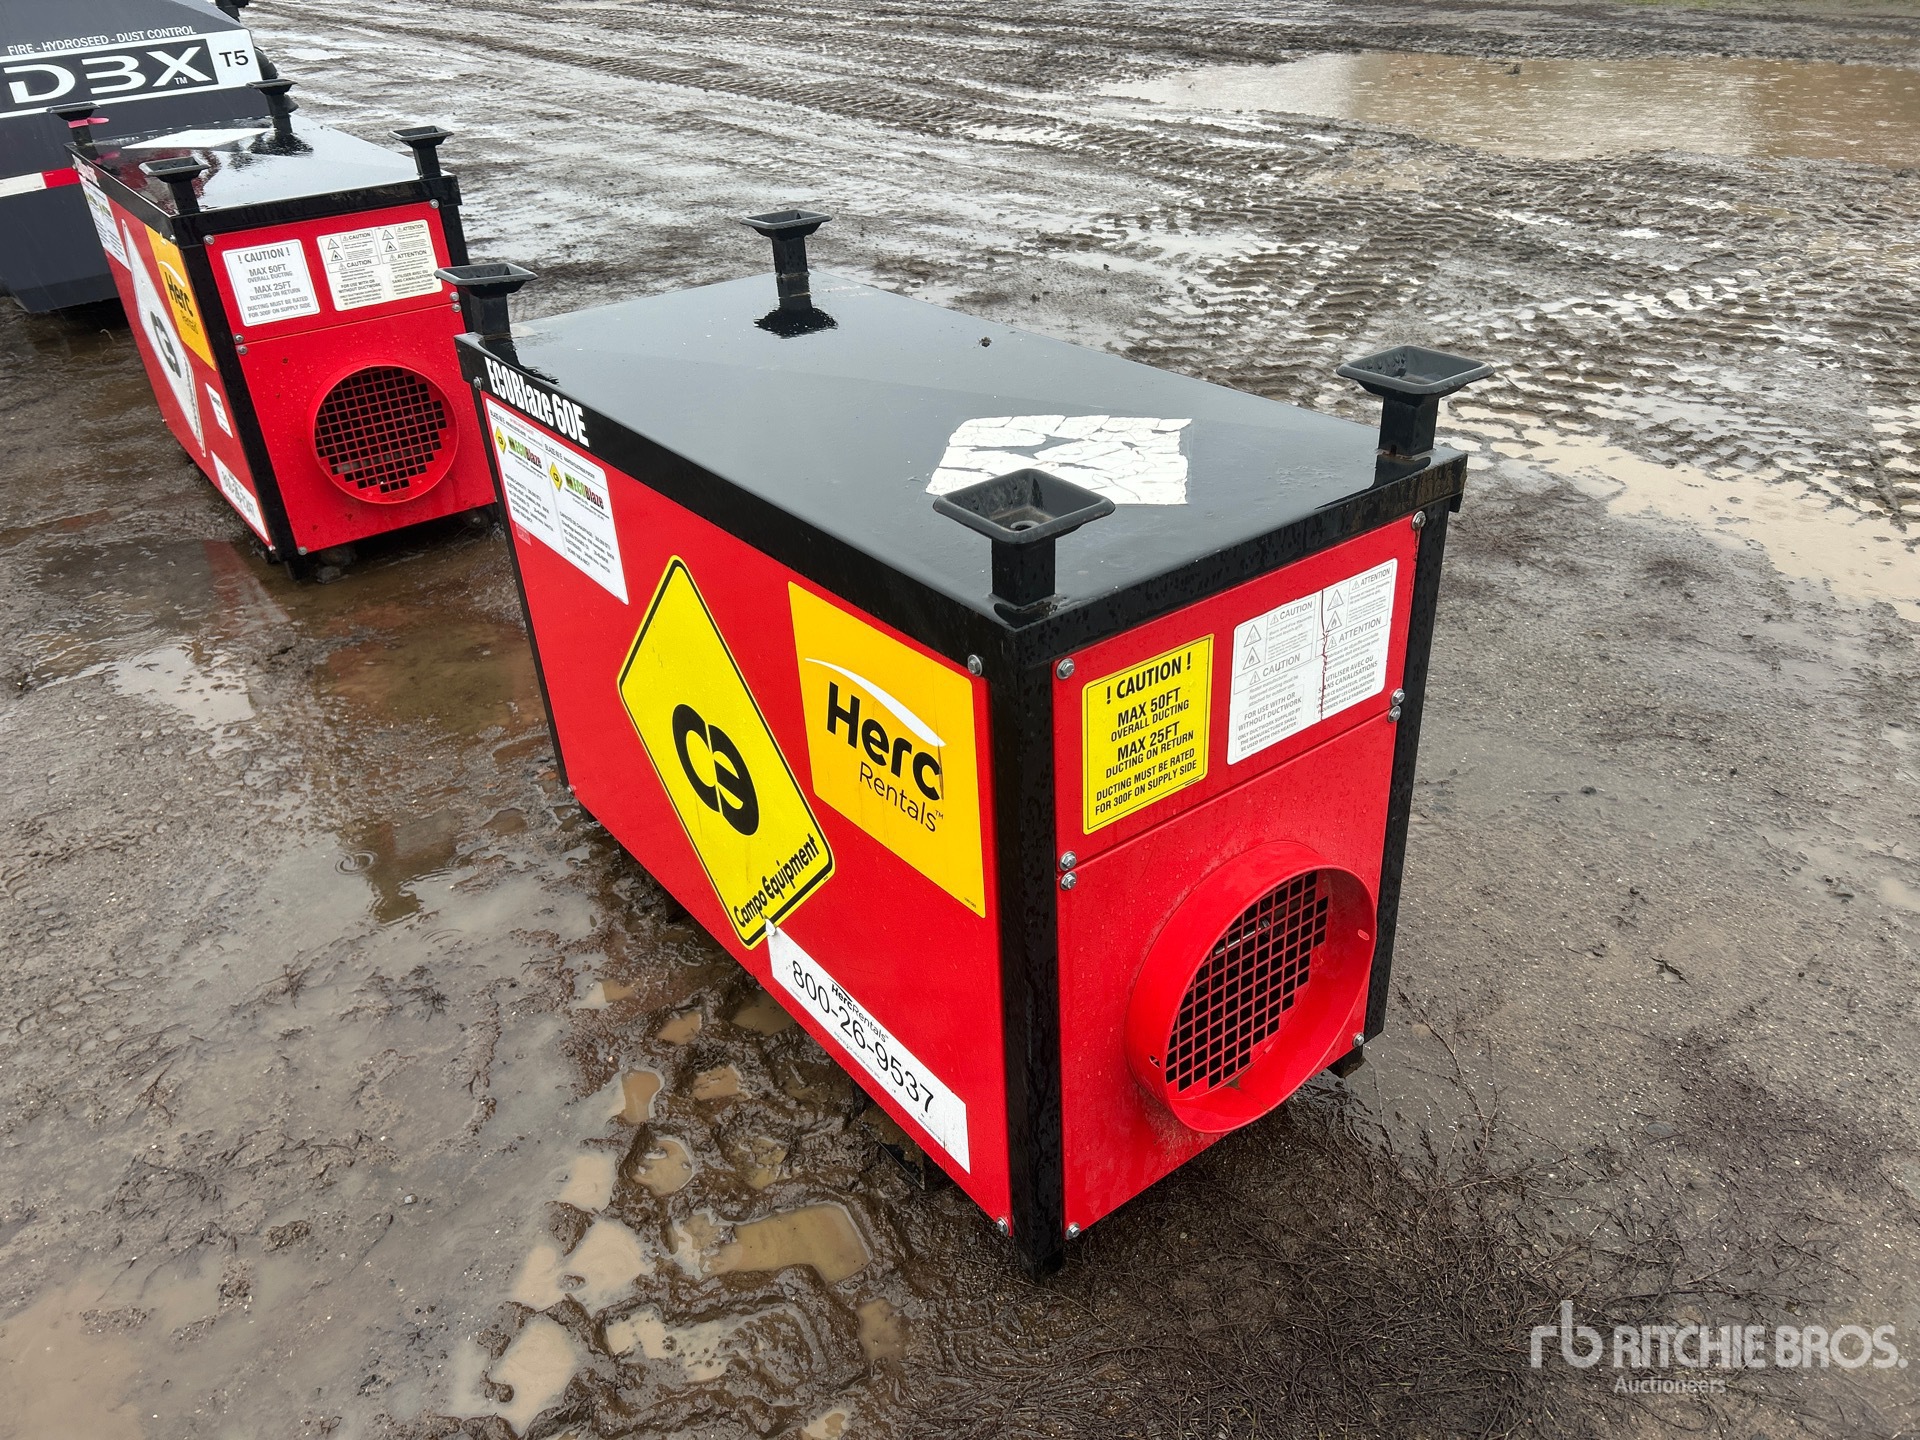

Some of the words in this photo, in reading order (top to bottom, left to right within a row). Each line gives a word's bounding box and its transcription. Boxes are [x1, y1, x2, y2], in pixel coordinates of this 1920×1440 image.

[7, 42, 33, 56] FIRE
[43, 36, 109, 52] HYDROSEED
[116, 32, 145, 45] DUST
[147, 25, 196, 39] CONTROL
[219, 50, 249, 67] T5
[348, 232, 370, 240] CAUTION
[243, 247, 284, 262] CAUTION
[346, 258, 372, 268] CAUTION
[396, 249, 427, 259] ATTENTION
[247, 274, 270, 283] OVERALL
[269, 270, 293, 279] DUCTING
[248, 266, 267, 276] MAX
[267, 263, 287, 273] 50FT
[164, 272, 194, 318] Herc
[249, 292, 272, 301] DUCTING
[253, 284, 272, 293] MAX
[272, 280, 292, 290] 25FT
[484, 356, 554, 429] ECOBlaze
[553, 393, 590, 448] 60E
[1360, 566, 1390, 586] ATTENTION
[1279, 599, 1312, 621] CAUTION
[1338, 615, 1381, 643] ATTENTION
[1116, 655, 1181, 700] CAUTION
[1262, 652, 1300, 677] CAUTION
[1325, 665, 1349, 682] UTILISER
[1349, 658, 1364, 671] AVEC
[1364, 654, 1373, 664] OU
[1334, 660, 1377, 686] CANALISATIONS
[1111, 716, 1149, 742] OVERALL
[1152, 698, 1189, 724] DUCTING
[1117, 701, 1146, 727] MAX
[1150, 686, 1180, 713] 50FT
[1238, 712, 1266, 732] WITHOUT
[1267, 696, 1301, 718] DUCTWORK
[1244, 709, 1256, 721] FOR
[1257, 703, 1269, 714] USE
[1269, 695, 1285, 709] WITH
[1286, 690, 1295, 701] OR
[826, 681, 942, 801] Herc
[1106, 752, 1143, 778] DUCTING
[1146, 746, 1158, 760] ON
[1160, 729, 1193, 753] RETURN
[1117, 735, 1145, 762] MAX
[1149, 720, 1179, 747] 25FT
[1095, 799, 1111, 815] FOR
[1113, 789, 1132, 807] 300F
[1134, 783, 1145, 797] ON
[1147, 768, 1177, 790] SUPPLY
[1179, 759, 1196, 775] SIDE
[1096, 776, 1131, 801] DUCTING
[1133, 765, 1156, 784] MUST
[1158, 759, 1168, 772] BE
[1170, 747, 1194, 767] RATED
[734, 889, 767, 928] Campo
[762, 833, 819, 900] Equipment
[792, 960, 934, 1113] 800-26-9537
